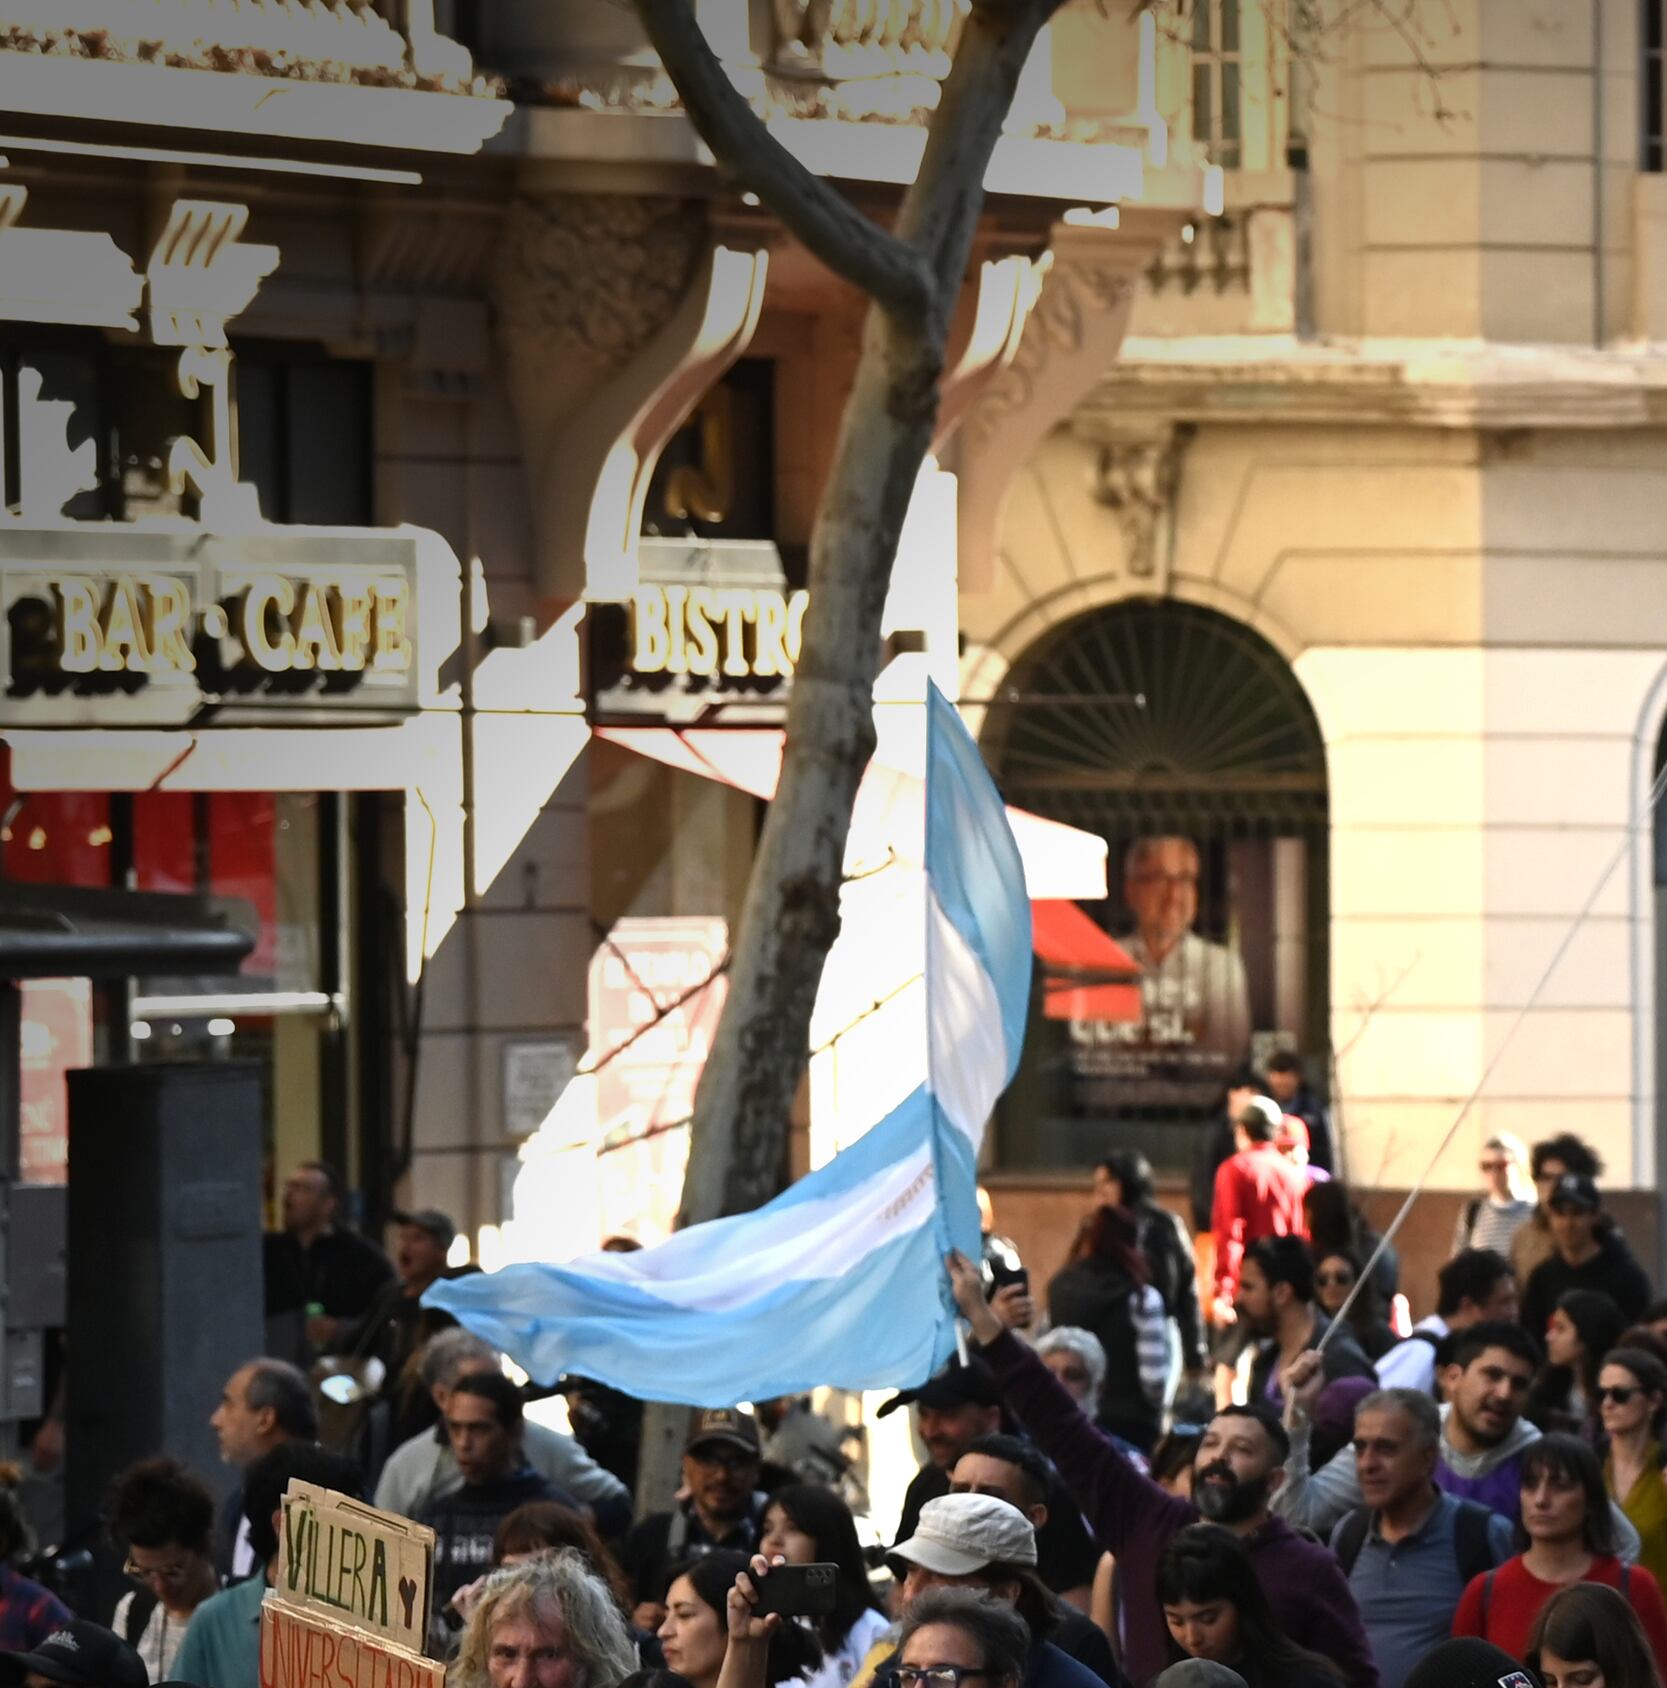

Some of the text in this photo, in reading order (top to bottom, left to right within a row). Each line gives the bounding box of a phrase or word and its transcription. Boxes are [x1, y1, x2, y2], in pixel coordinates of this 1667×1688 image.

[56, 572, 413, 674] BAR CAFE
[398, 1574, 418, 1630] Y
